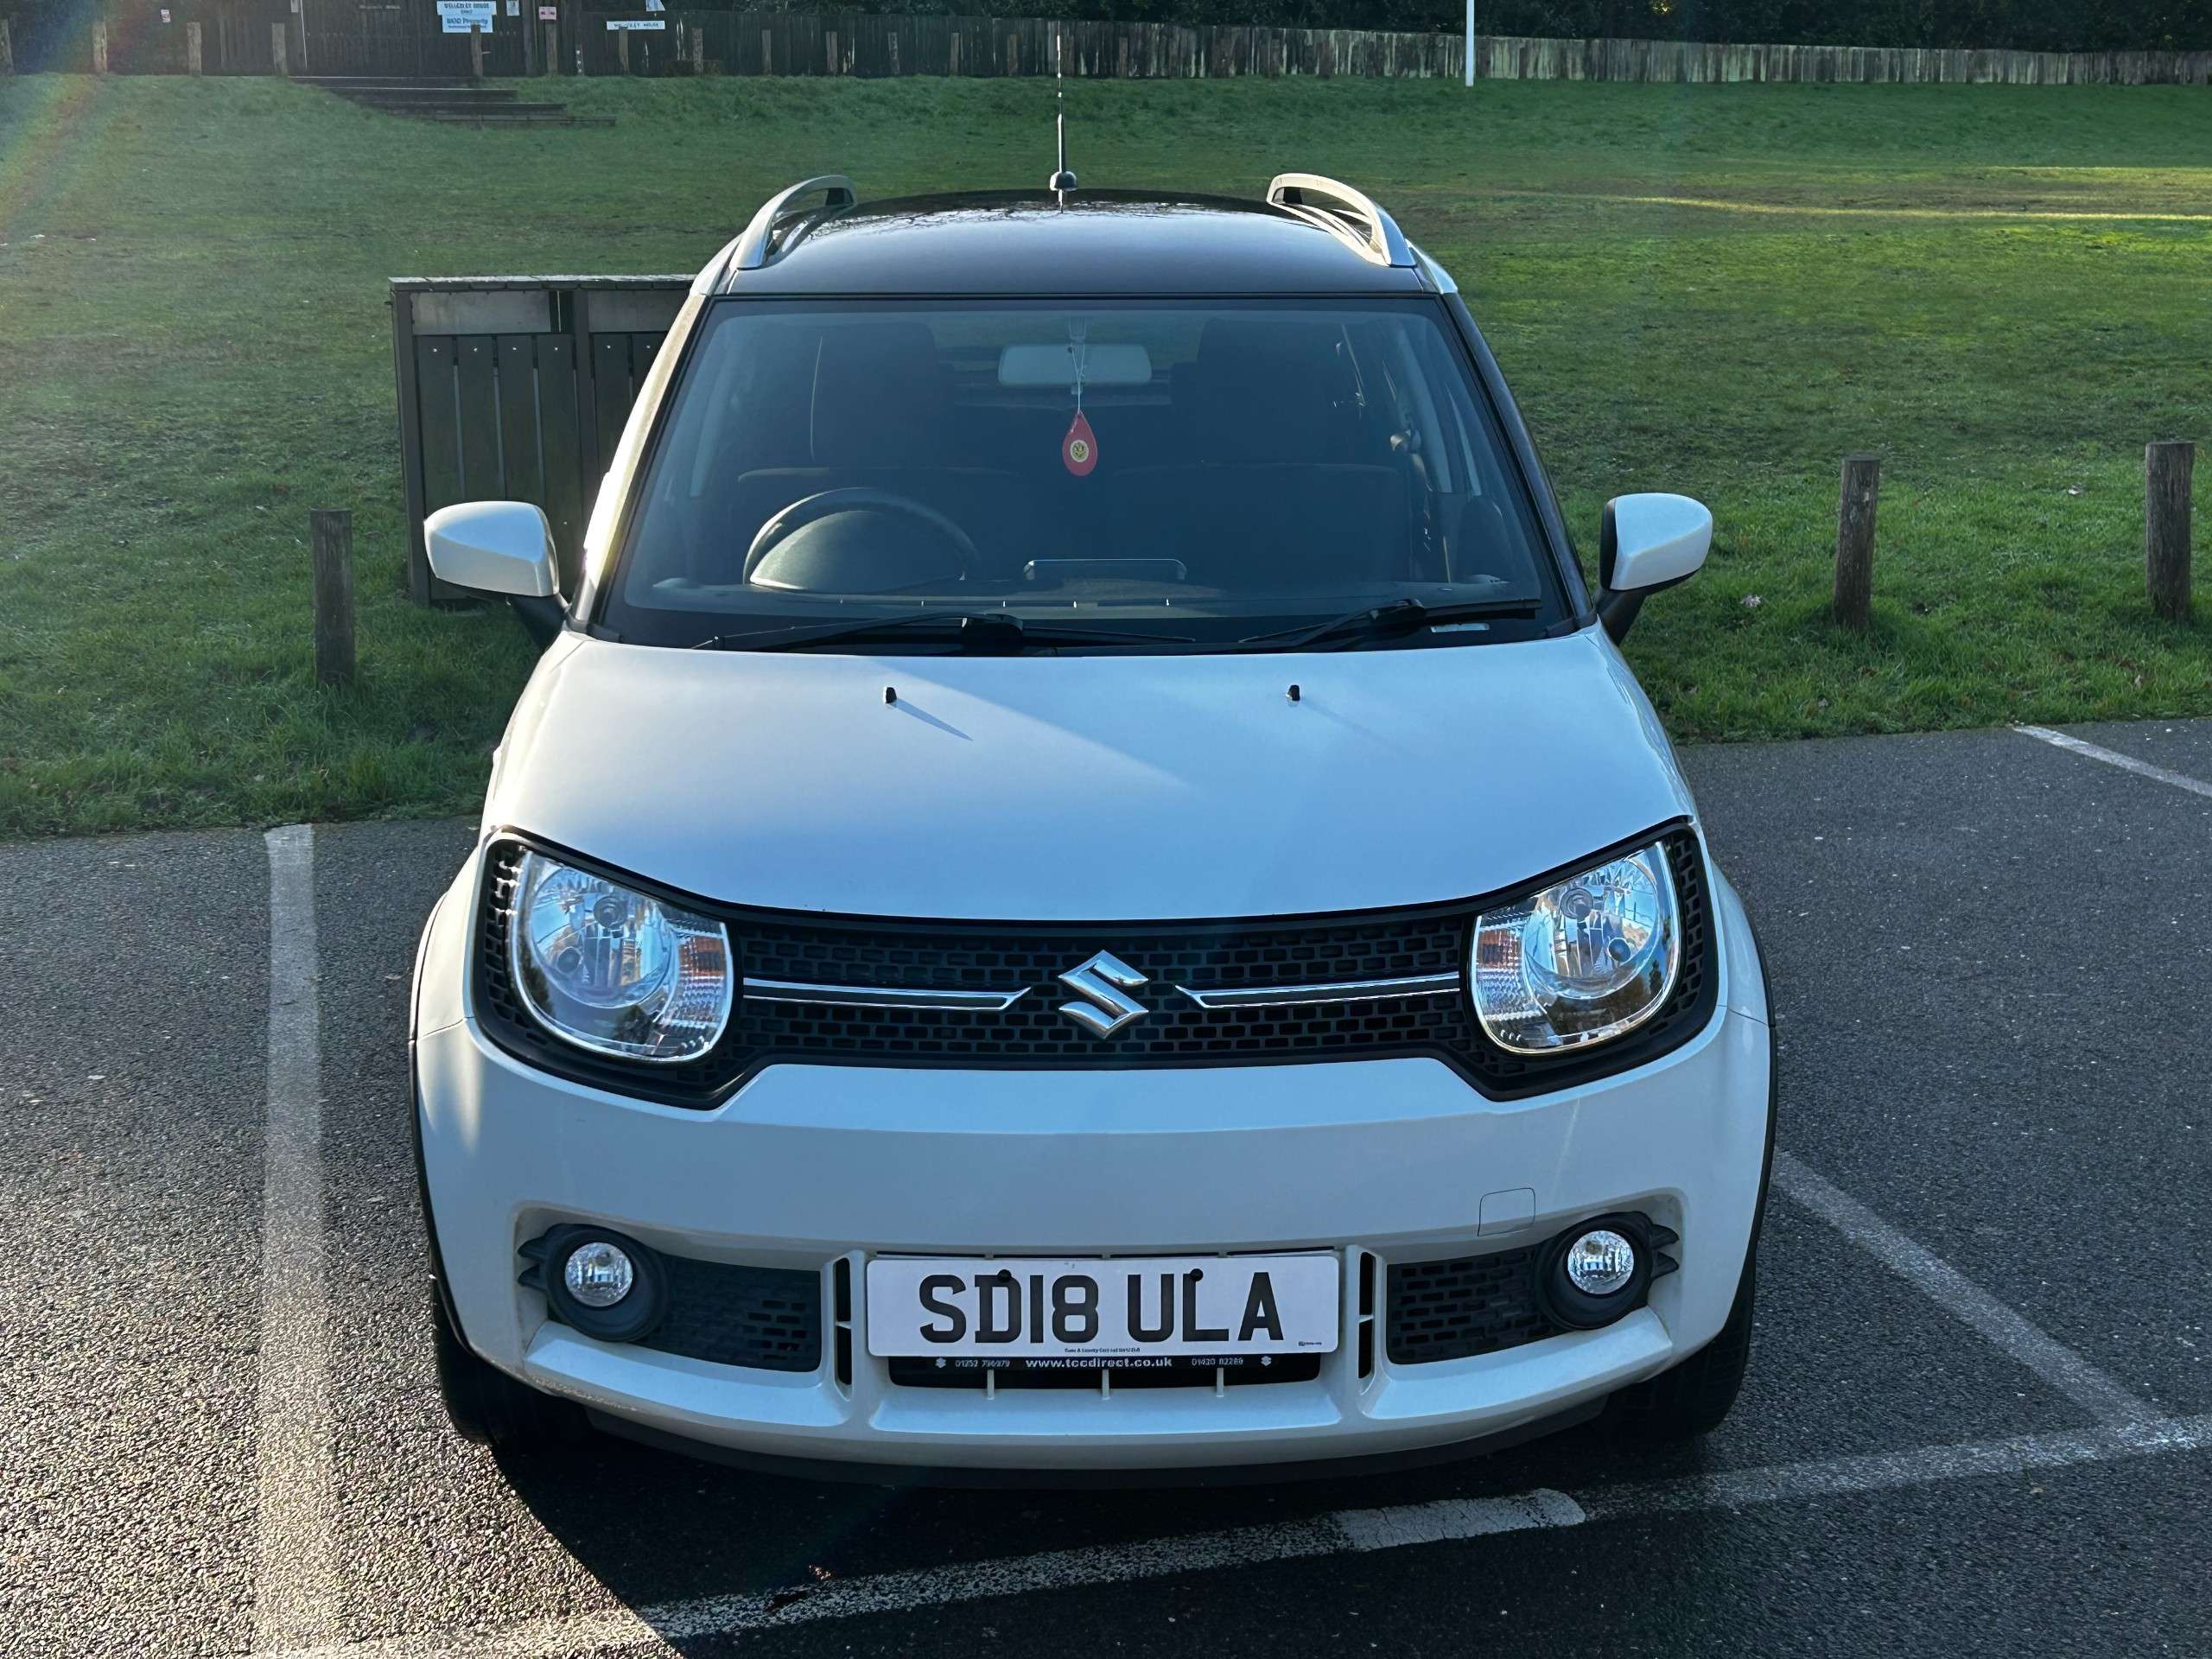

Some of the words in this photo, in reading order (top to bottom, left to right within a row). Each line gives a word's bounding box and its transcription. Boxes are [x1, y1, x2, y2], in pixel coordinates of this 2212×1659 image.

[919, 1274, 1098, 1343] SD18
[1128, 1272, 1284, 1342] ULA
[1026, 1357, 1173, 1369] www.tccdirect.co.uk
